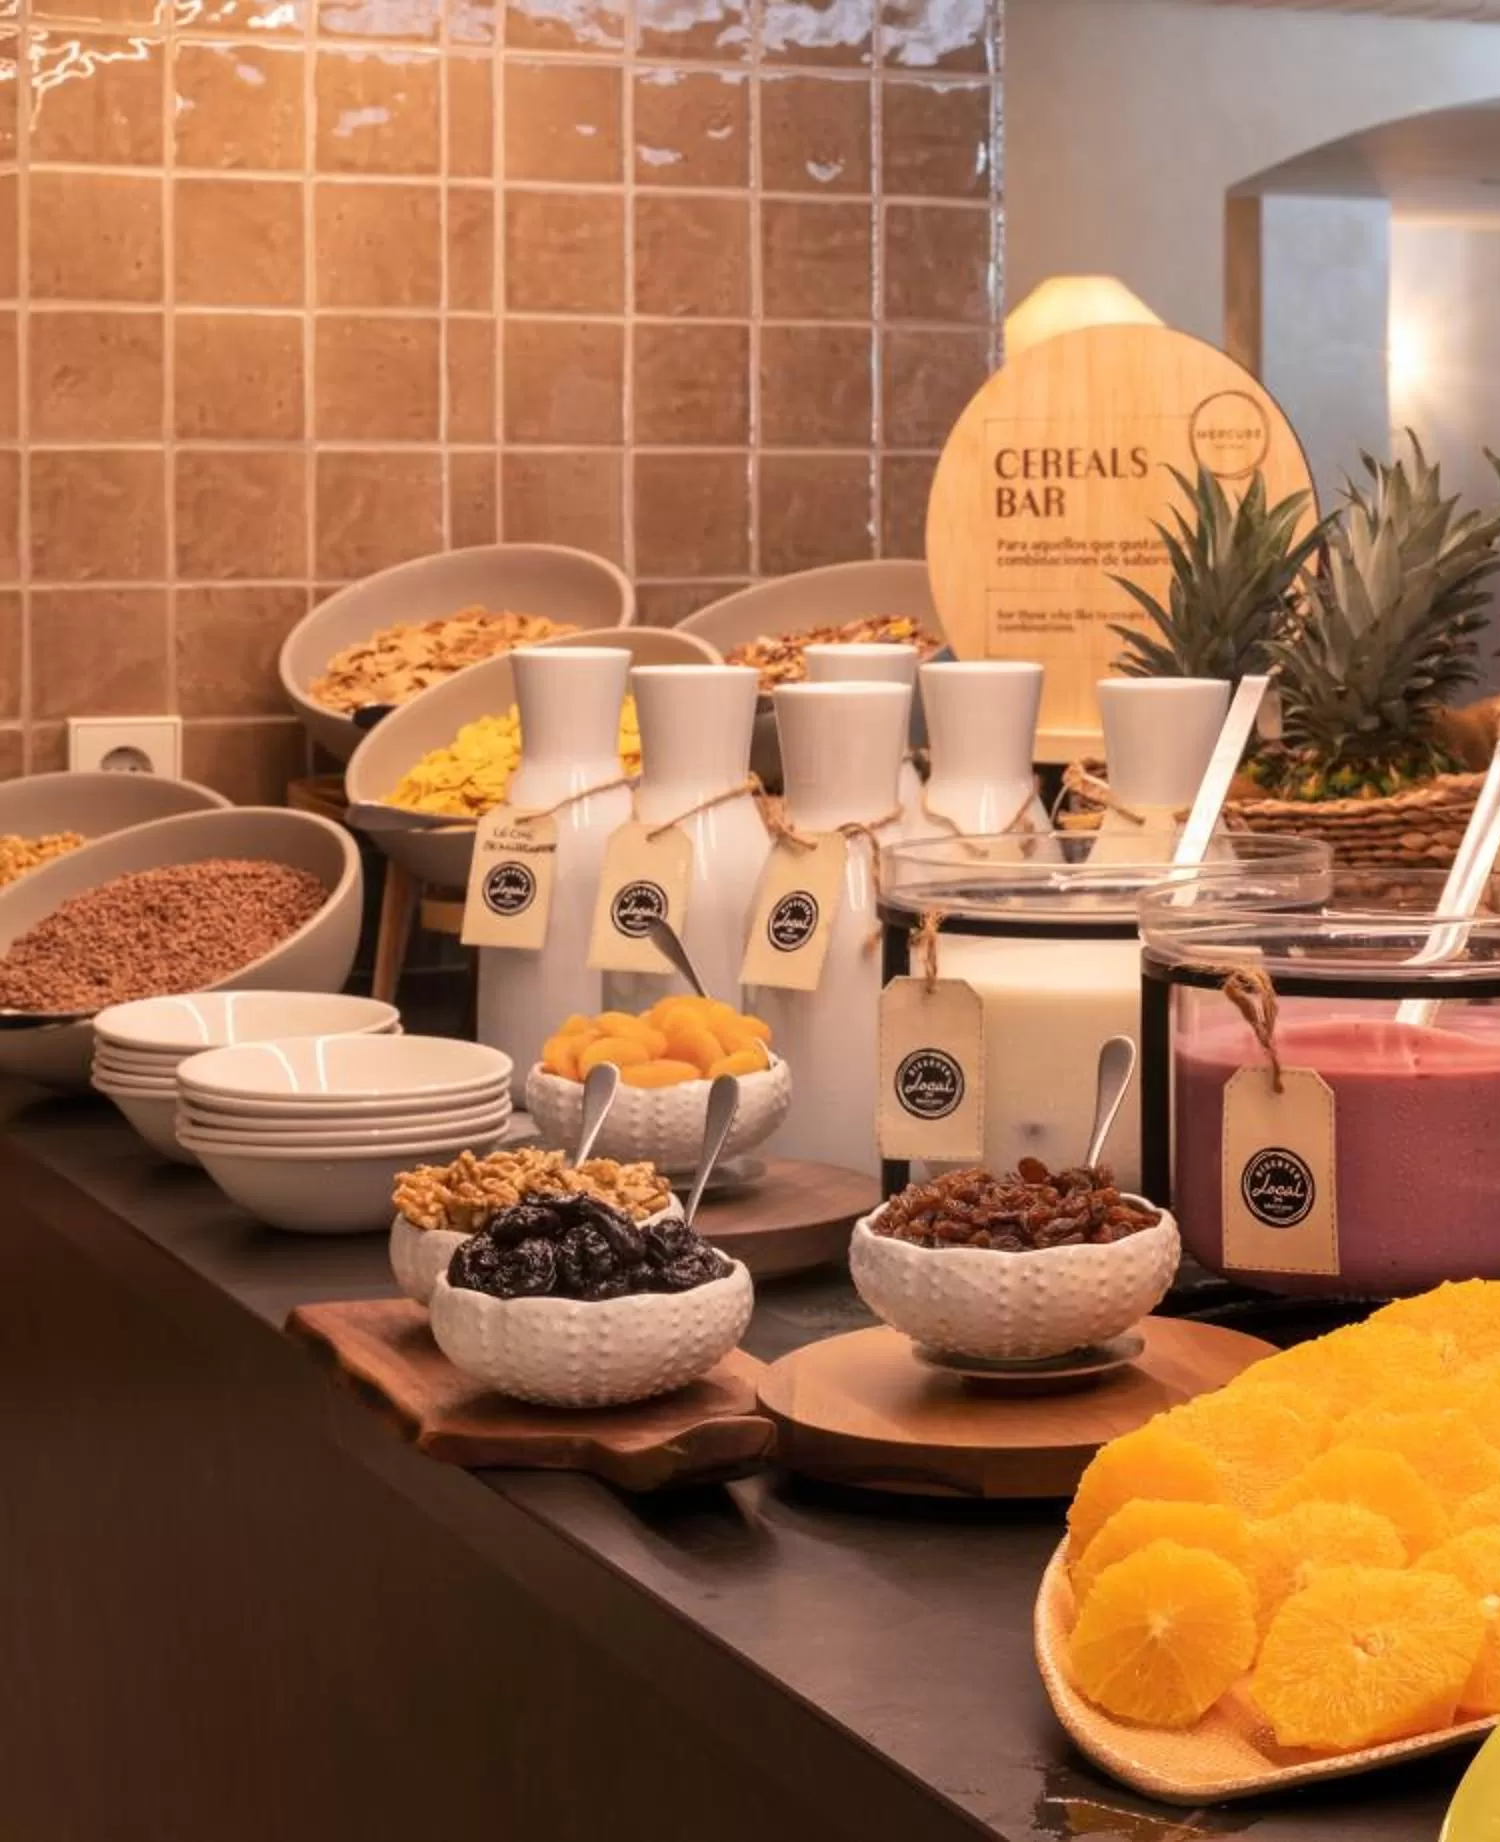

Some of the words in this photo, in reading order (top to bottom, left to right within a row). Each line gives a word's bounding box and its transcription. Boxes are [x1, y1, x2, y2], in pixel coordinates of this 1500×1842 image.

[994, 447, 1148, 480] CEREALS
[996, 485, 1065, 518] BAR
[1090, 540, 1114, 554] que
[1101, 553, 1119, 566] de
[905, 1072, 955, 1094] Local
[1251, 1174, 1305, 1198] Local
